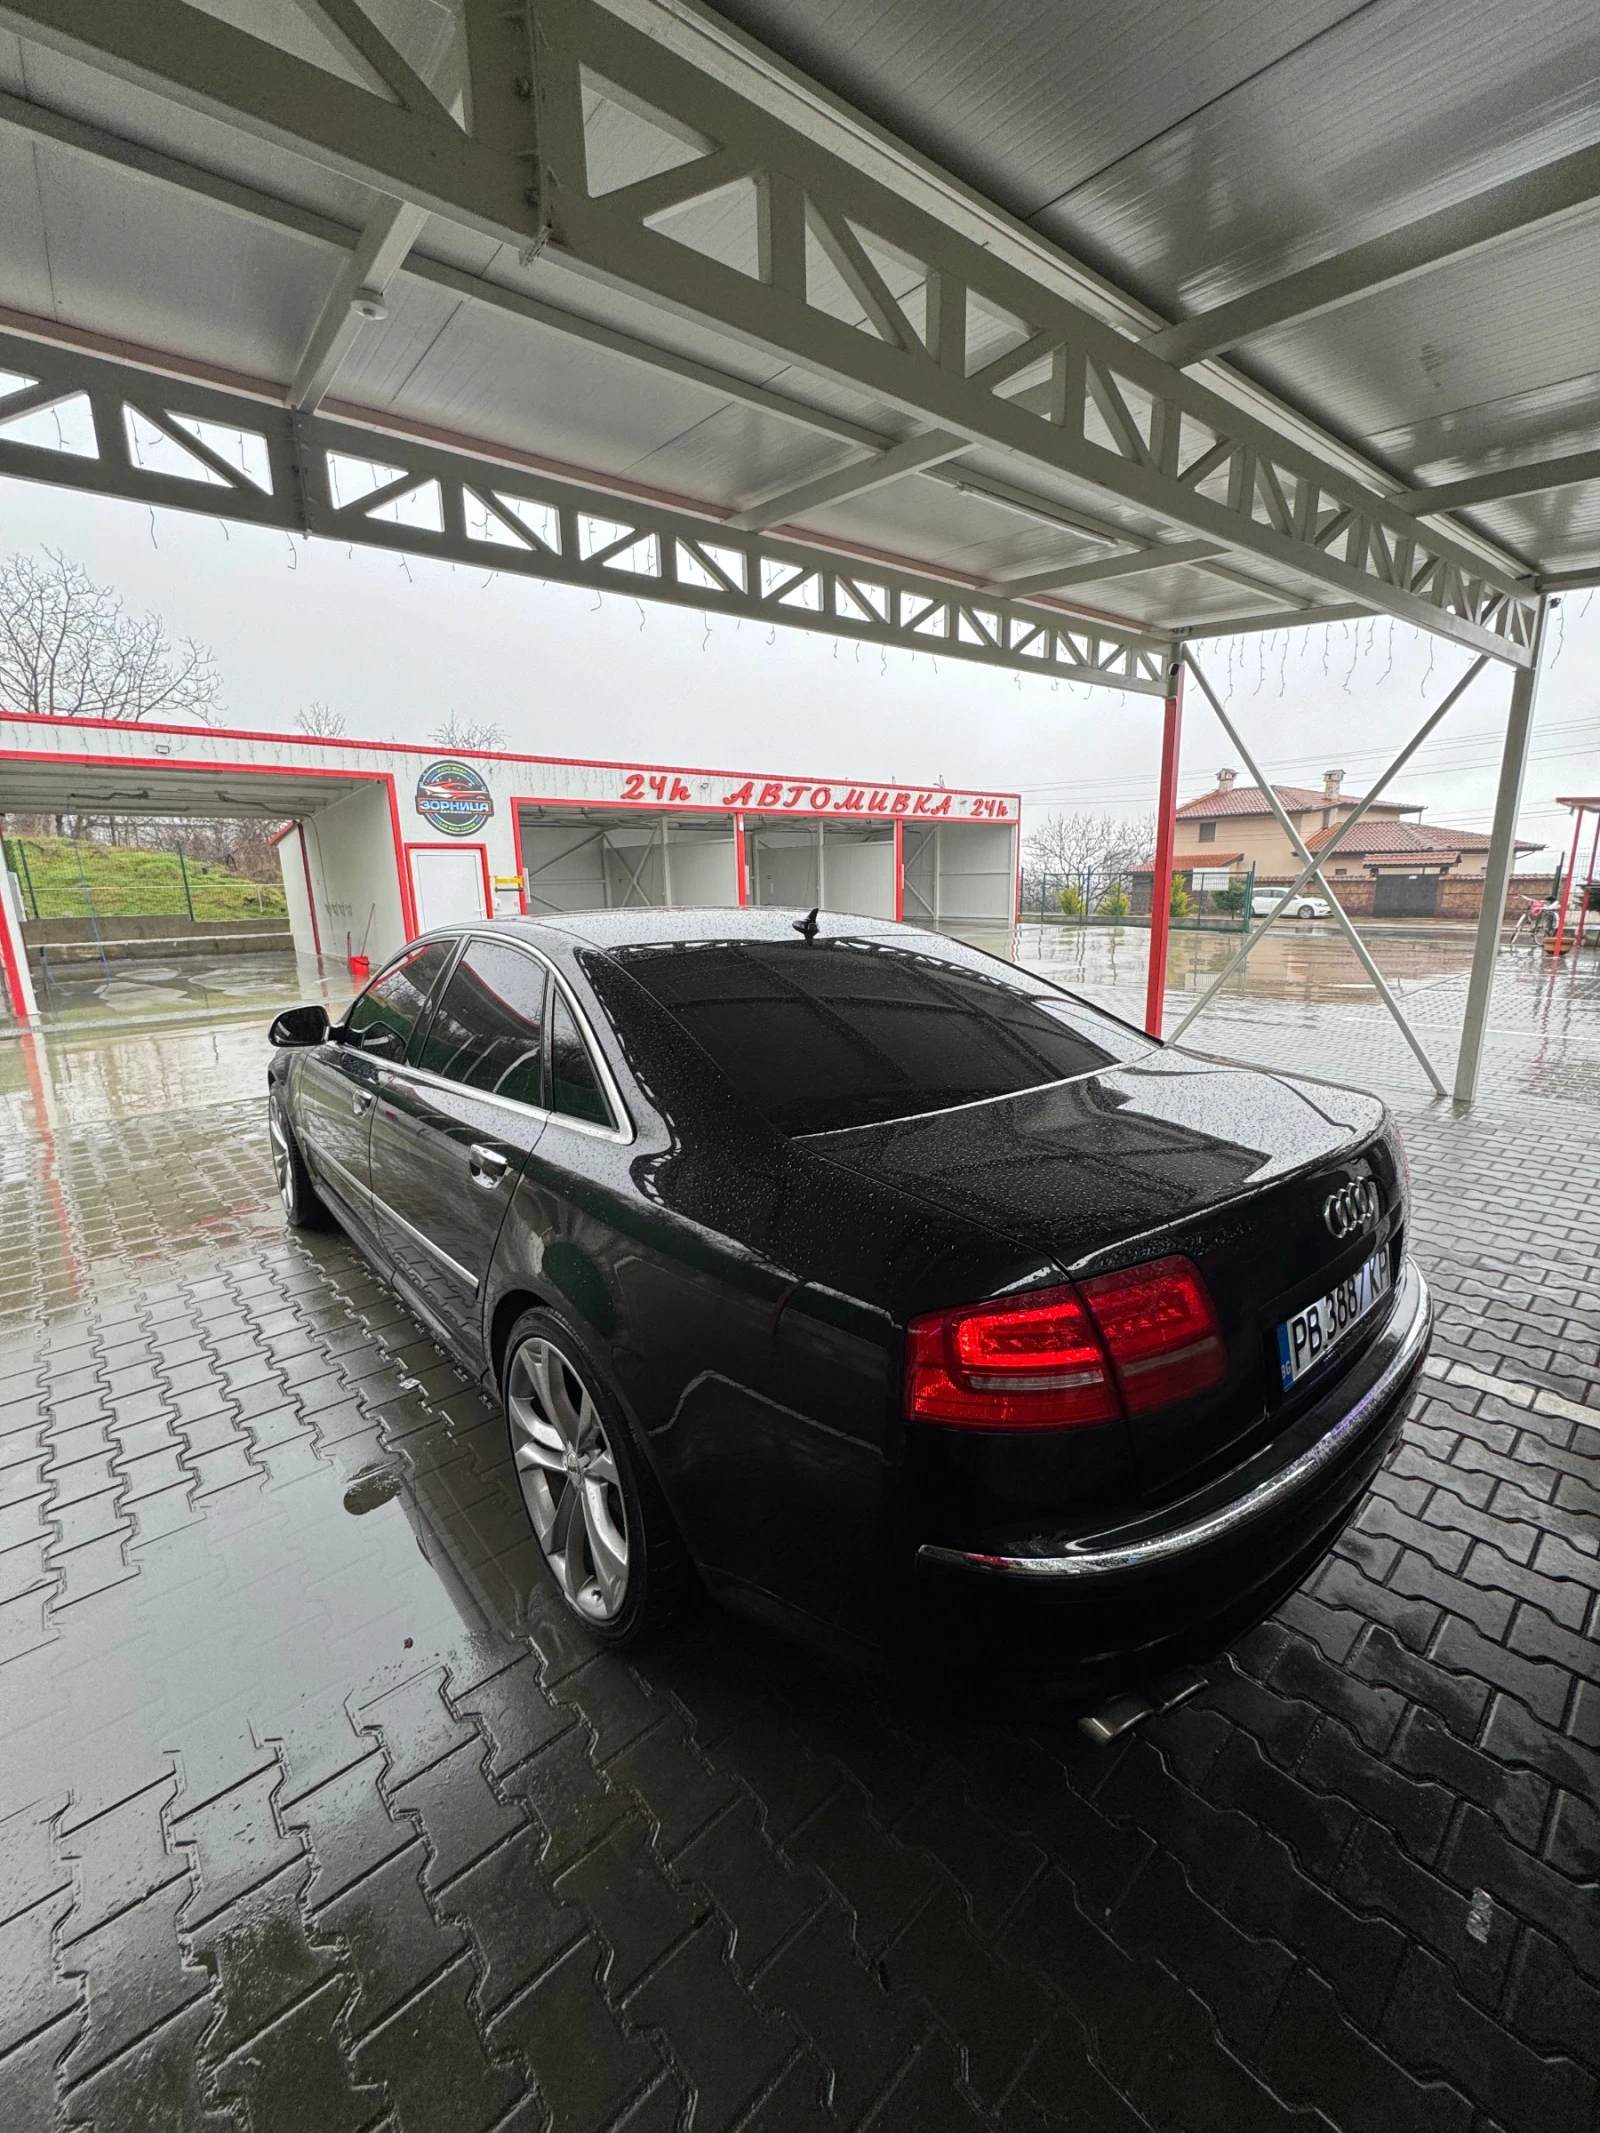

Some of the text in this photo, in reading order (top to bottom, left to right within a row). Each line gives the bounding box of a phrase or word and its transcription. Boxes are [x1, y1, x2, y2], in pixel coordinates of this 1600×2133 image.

[620, 774, 691, 800] 24h
[420, 800, 489, 812] ЗОРНИЦА
[722, 781, 953, 816] АВТОМИВКА
[970, 798, 1008, 817] 24h
